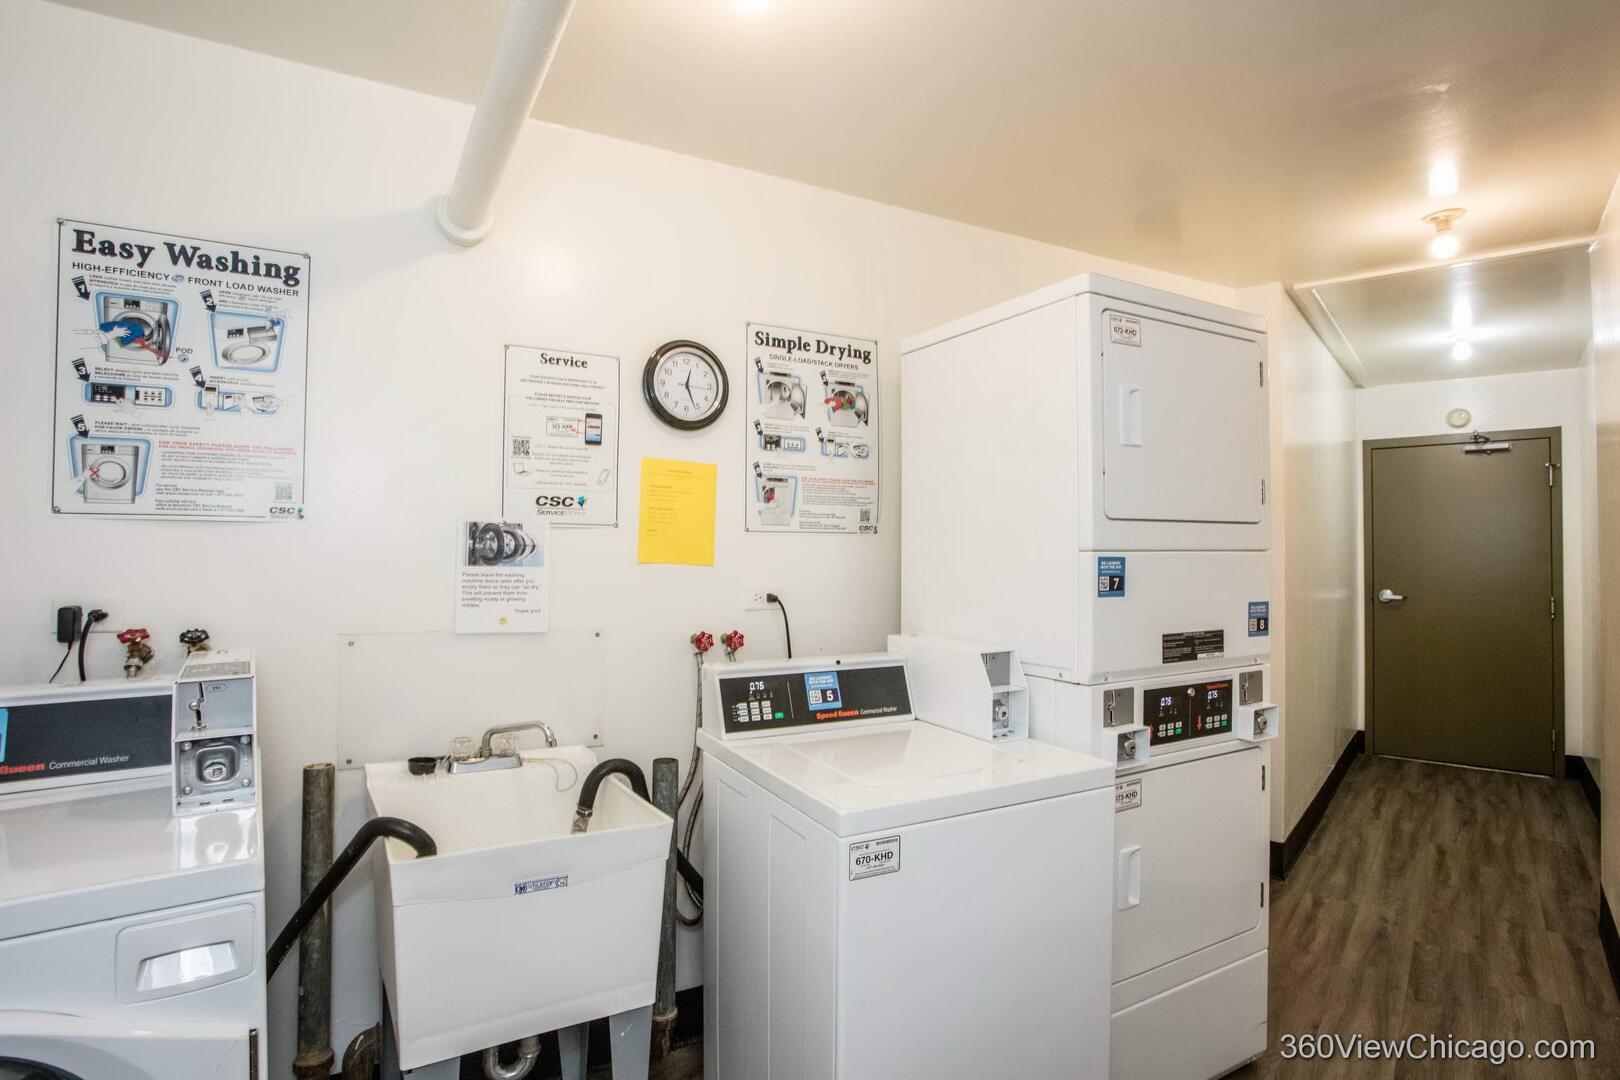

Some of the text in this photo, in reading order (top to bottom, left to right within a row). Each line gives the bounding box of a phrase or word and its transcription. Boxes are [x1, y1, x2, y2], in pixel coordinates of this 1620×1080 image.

[72, 228, 301, 288] Easy Washing
[72, 261, 171, 281] HIGH-EFFICIENCY
[187, 276, 223, 288] FRONT
[226, 281, 254, 292] LOAD
[257, 285, 300, 297] WASHER
[175, 346, 193, 355] POD
[755, 330, 872, 365] Simple Drying
[540, 352, 588, 369] Service
[834, 362, 859, 370] DRYERS
[664, 368, 672, 376] 10
[706, 383, 712, 391] 3
[664, 391, 669, 399] 8
[673, 401, 679, 409] 7
[77, 423, 86, 432] 5
[535, 495, 575, 507] CSC
[269, 506, 295, 515] CSC
[1113, 577, 1120, 590] 7
[1259, 619, 1265, 630] 8
[826, 690, 834, 702] 5
[816, 711, 838, 721] Speed
[838, 709, 860, 718] Queen
[860, 707, 882, 716] Commercial
[49, 757, 98, 770] Commercial
[99, 753, 130, 764] Washer
[855, 851, 894, 866] 670-KHD
